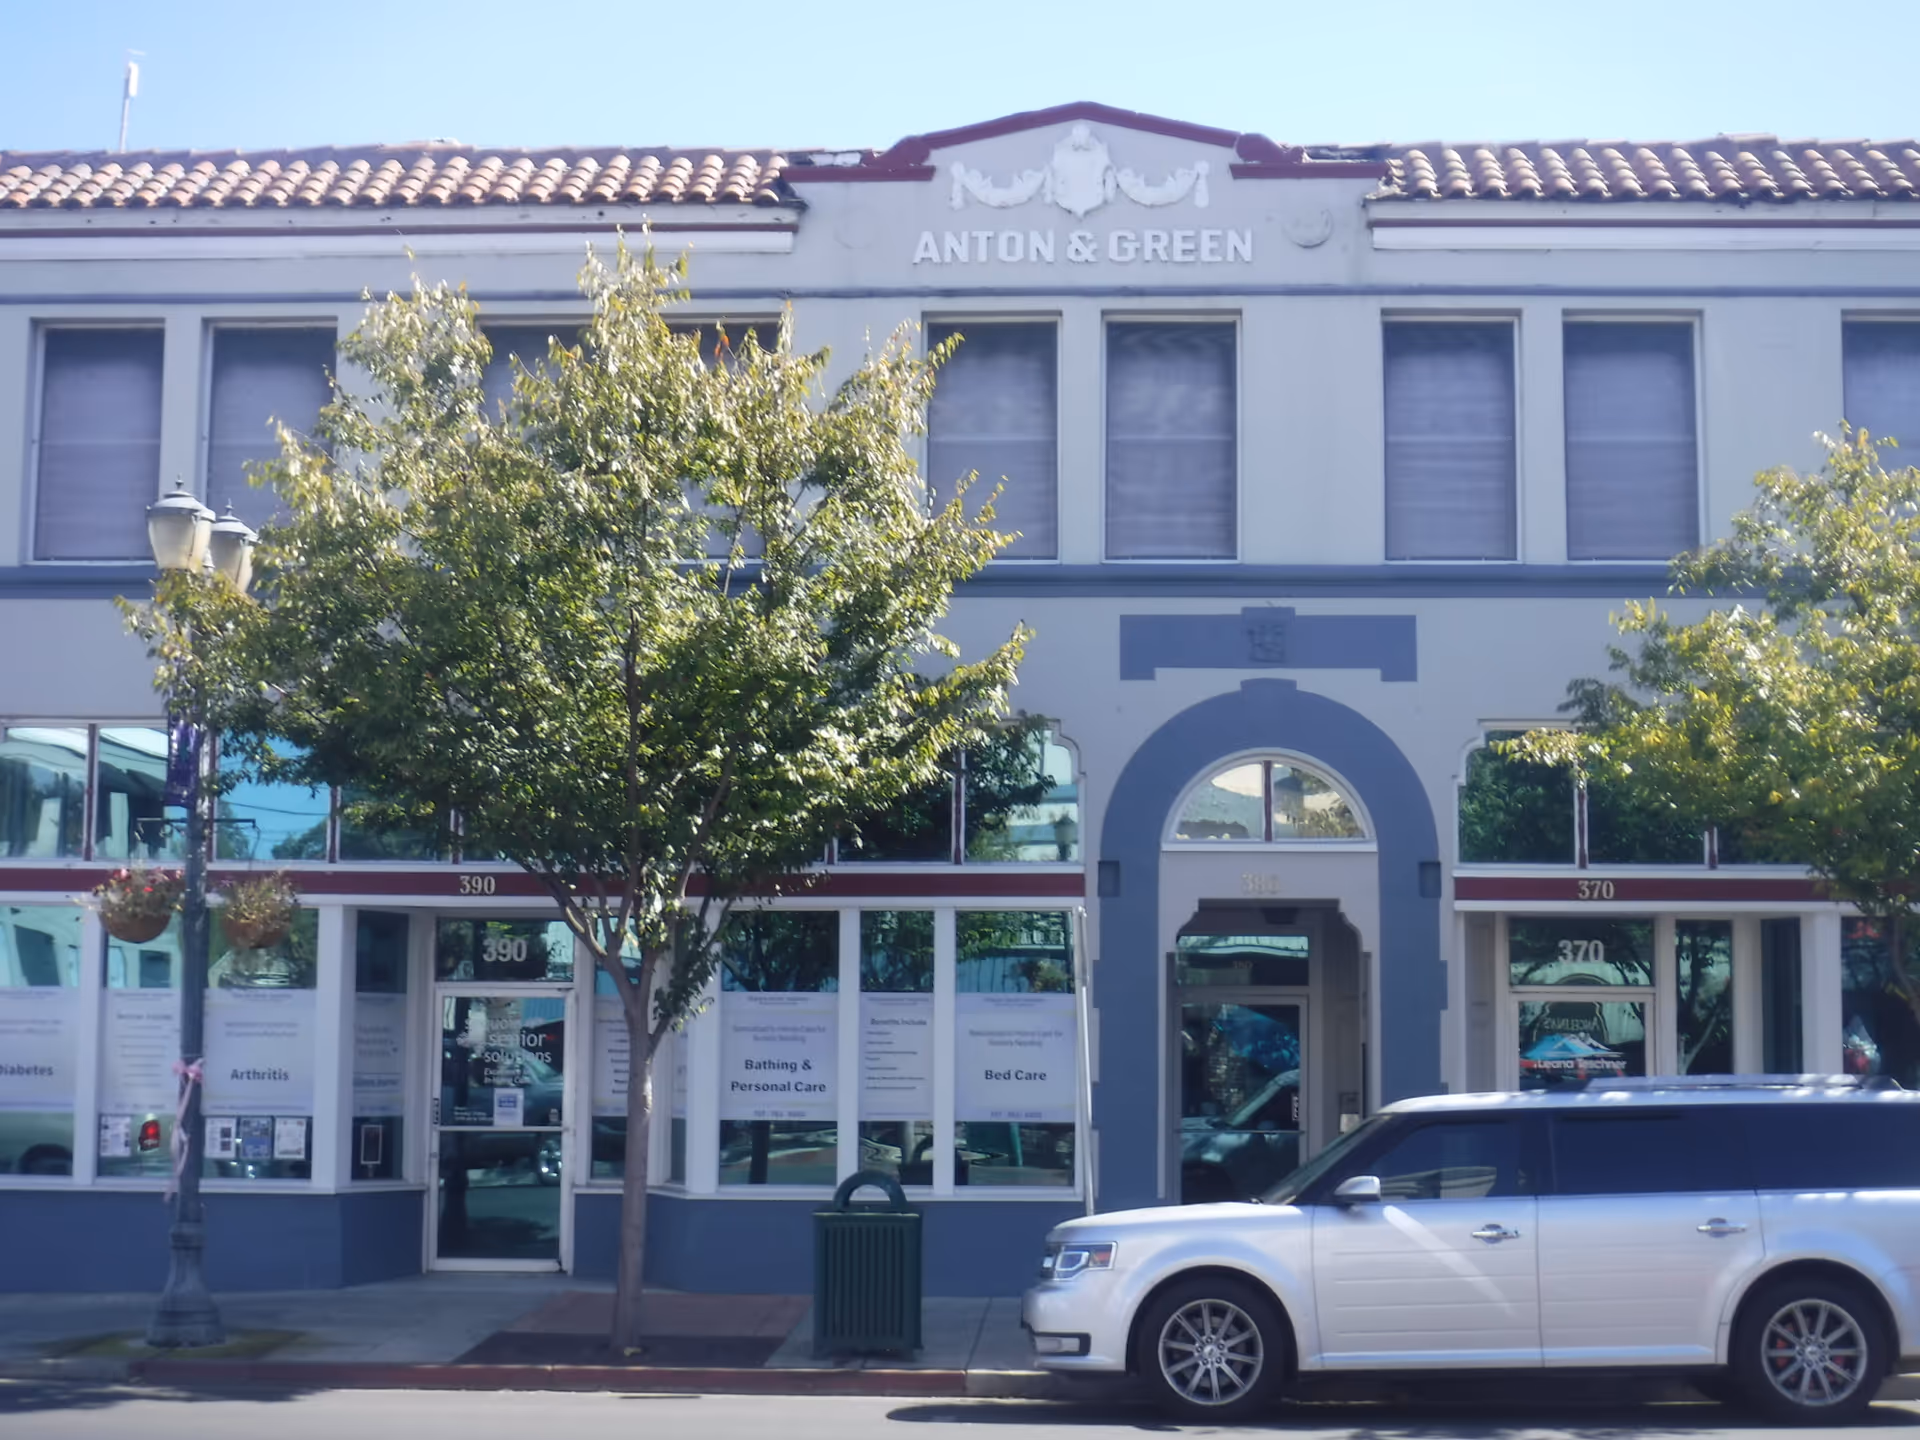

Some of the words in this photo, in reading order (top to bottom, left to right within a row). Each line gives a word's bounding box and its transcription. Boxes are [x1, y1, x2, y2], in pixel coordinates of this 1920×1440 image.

[913, 230, 1055, 265] ANTON
[1067, 230, 1098, 264] &
[1108, 228, 1253, 264] GREEN
[459, 875, 496, 895] 390
[1578, 880, 1615, 900] 370
[483, 939, 528, 962] 390
[1558, 940, 1605, 963] 370
[230, 1068, 290, 1082] Arthritis
[744, 1059, 797, 1073] Bathing
[801, 1059, 812, 1071] &
[984, 1070, 1011, 1081] Bed
[1015, 1070, 1047, 1081] Care
[731, 1081, 791, 1092] Personal
[795, 1081, 827, 1092] Care
